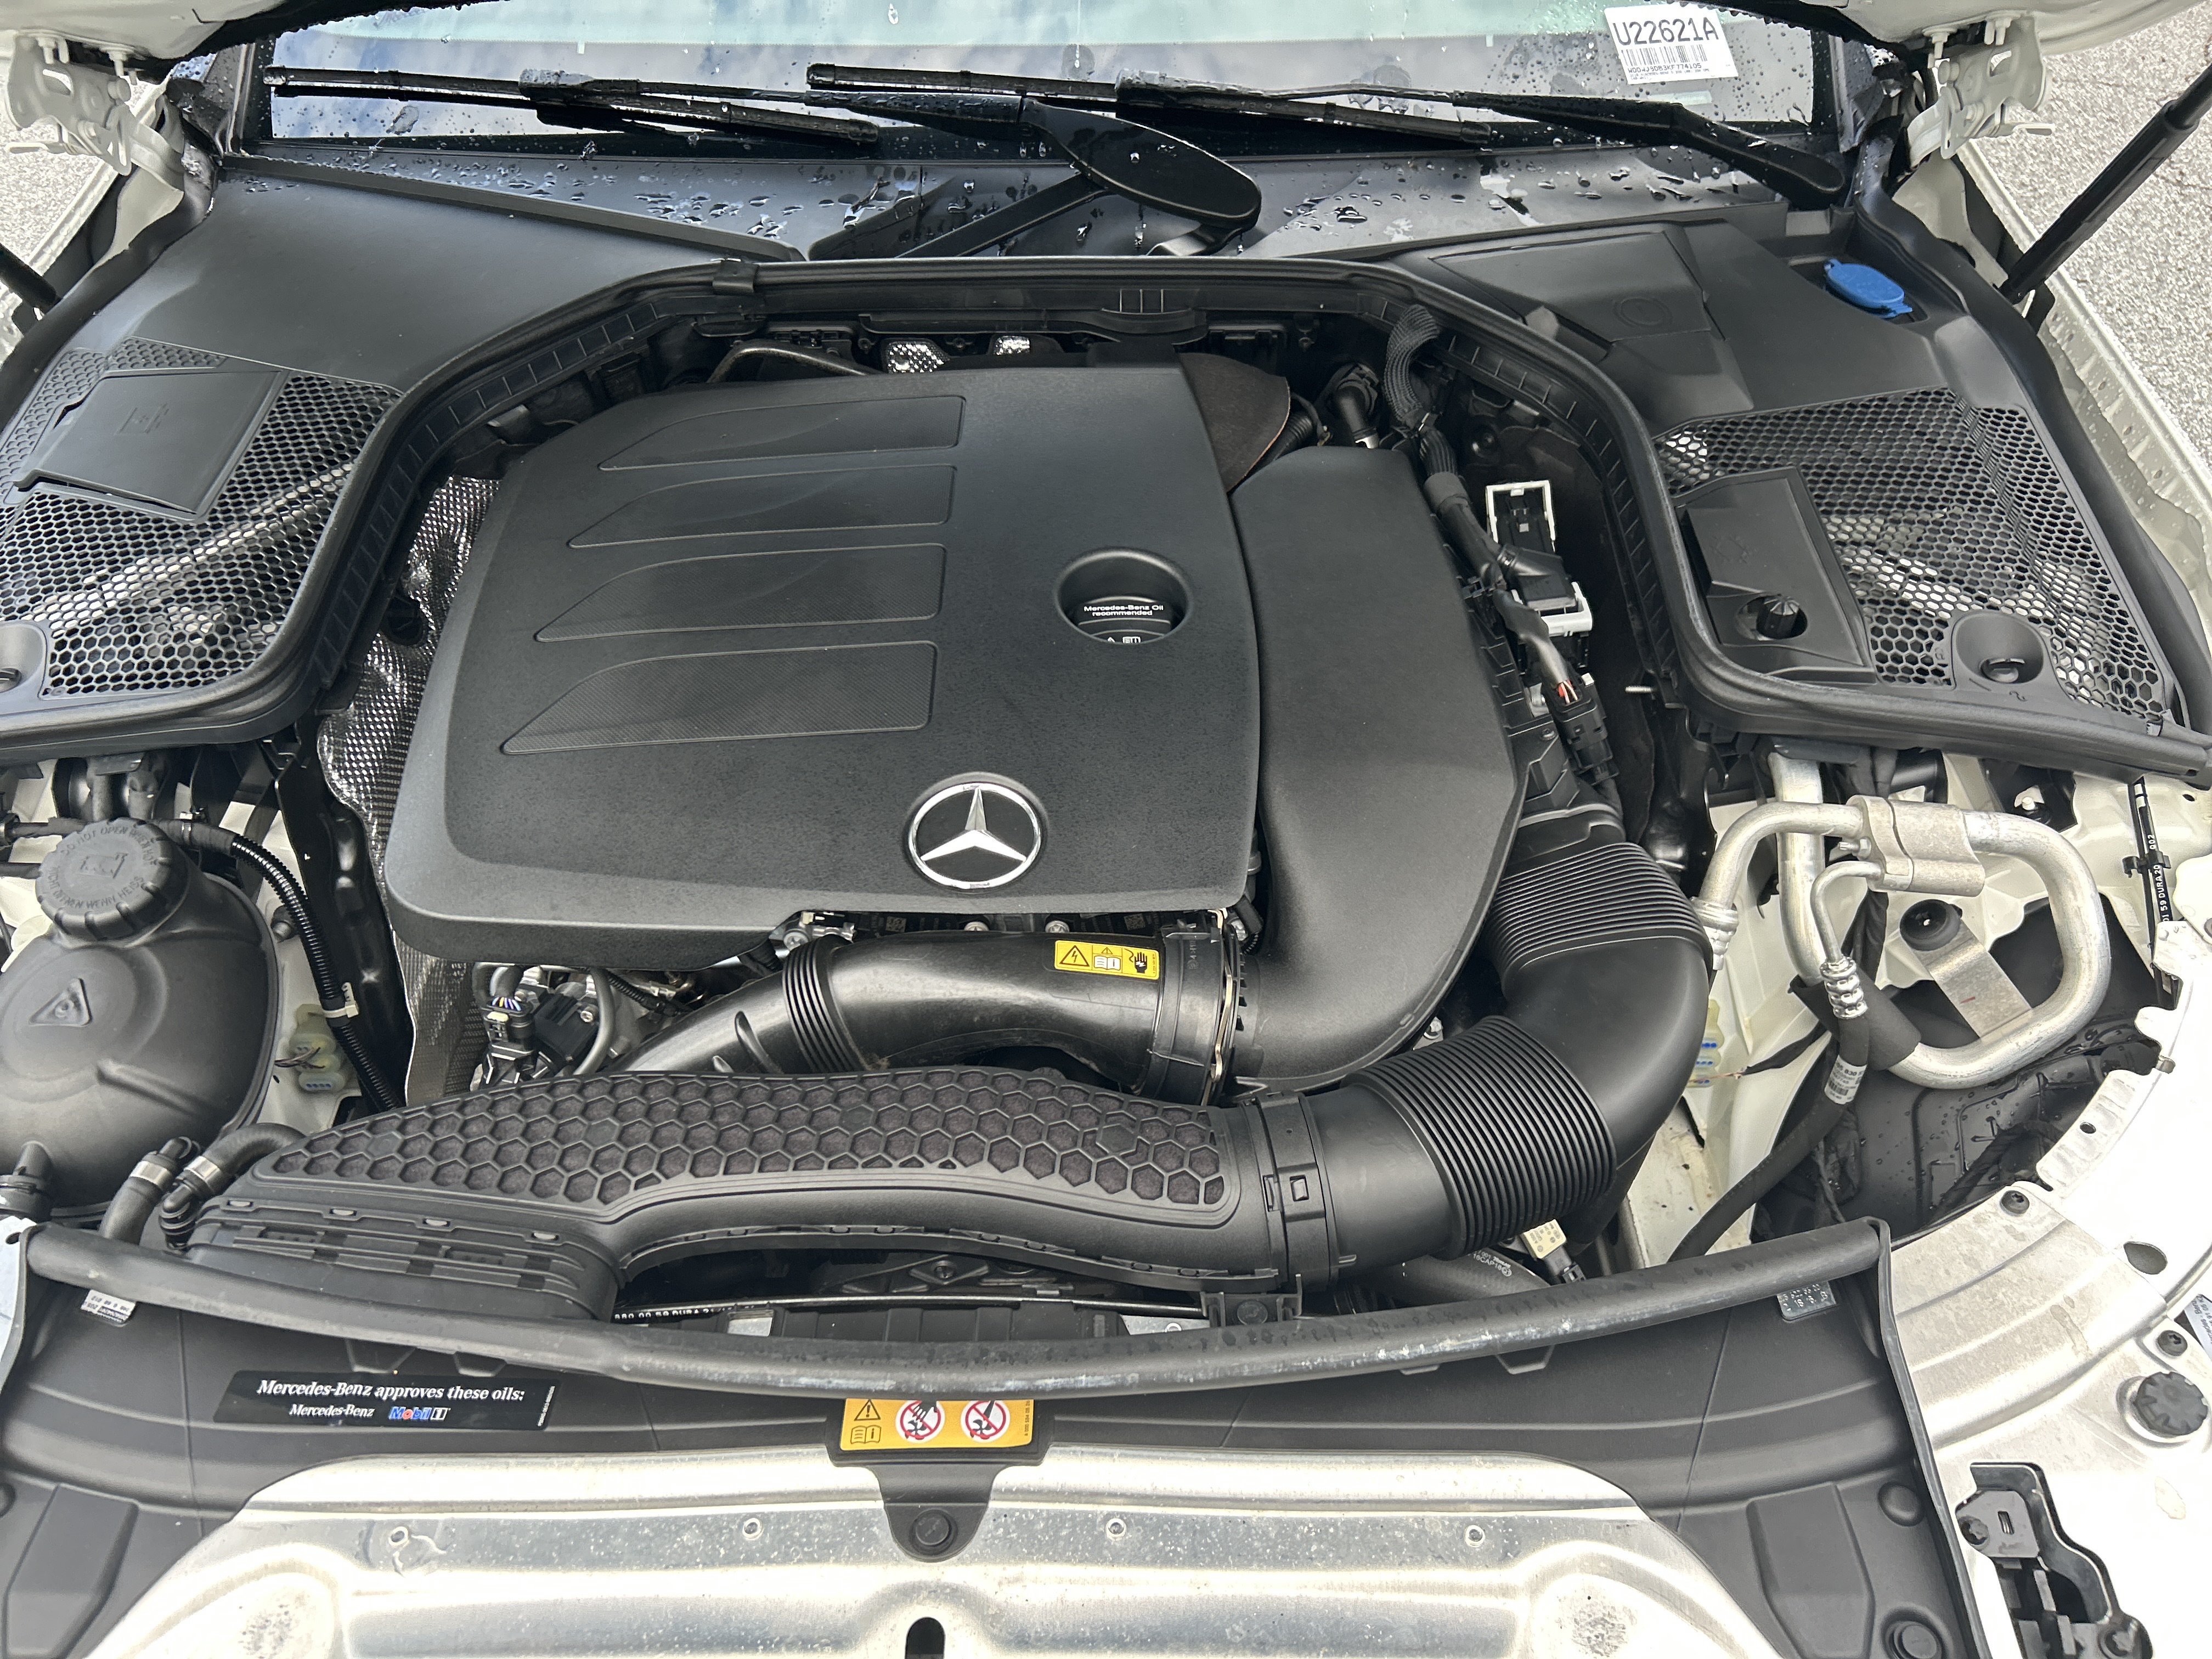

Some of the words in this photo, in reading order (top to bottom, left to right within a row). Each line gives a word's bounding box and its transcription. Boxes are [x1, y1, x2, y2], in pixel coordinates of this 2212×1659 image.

[1612, 16, 1719, 46] U22621A
[100, 826, 128, 834] OPEN
[2147, 834, 2157, 850] 002
[2155, 876, 2165, 899] DURA
[2160, 900, 2168, 911] 59
[256, 1380, 371, 1397] Mercedes-Benz
[374, 1387, 444, 1401] approves
[447, 1386, 489, 1400] these
[492, 1387, 526, 1401] oils:
[289, 1403, 375, 1418] Mercedes-Benz
[388, 1406, 431, 1420] Mobil
